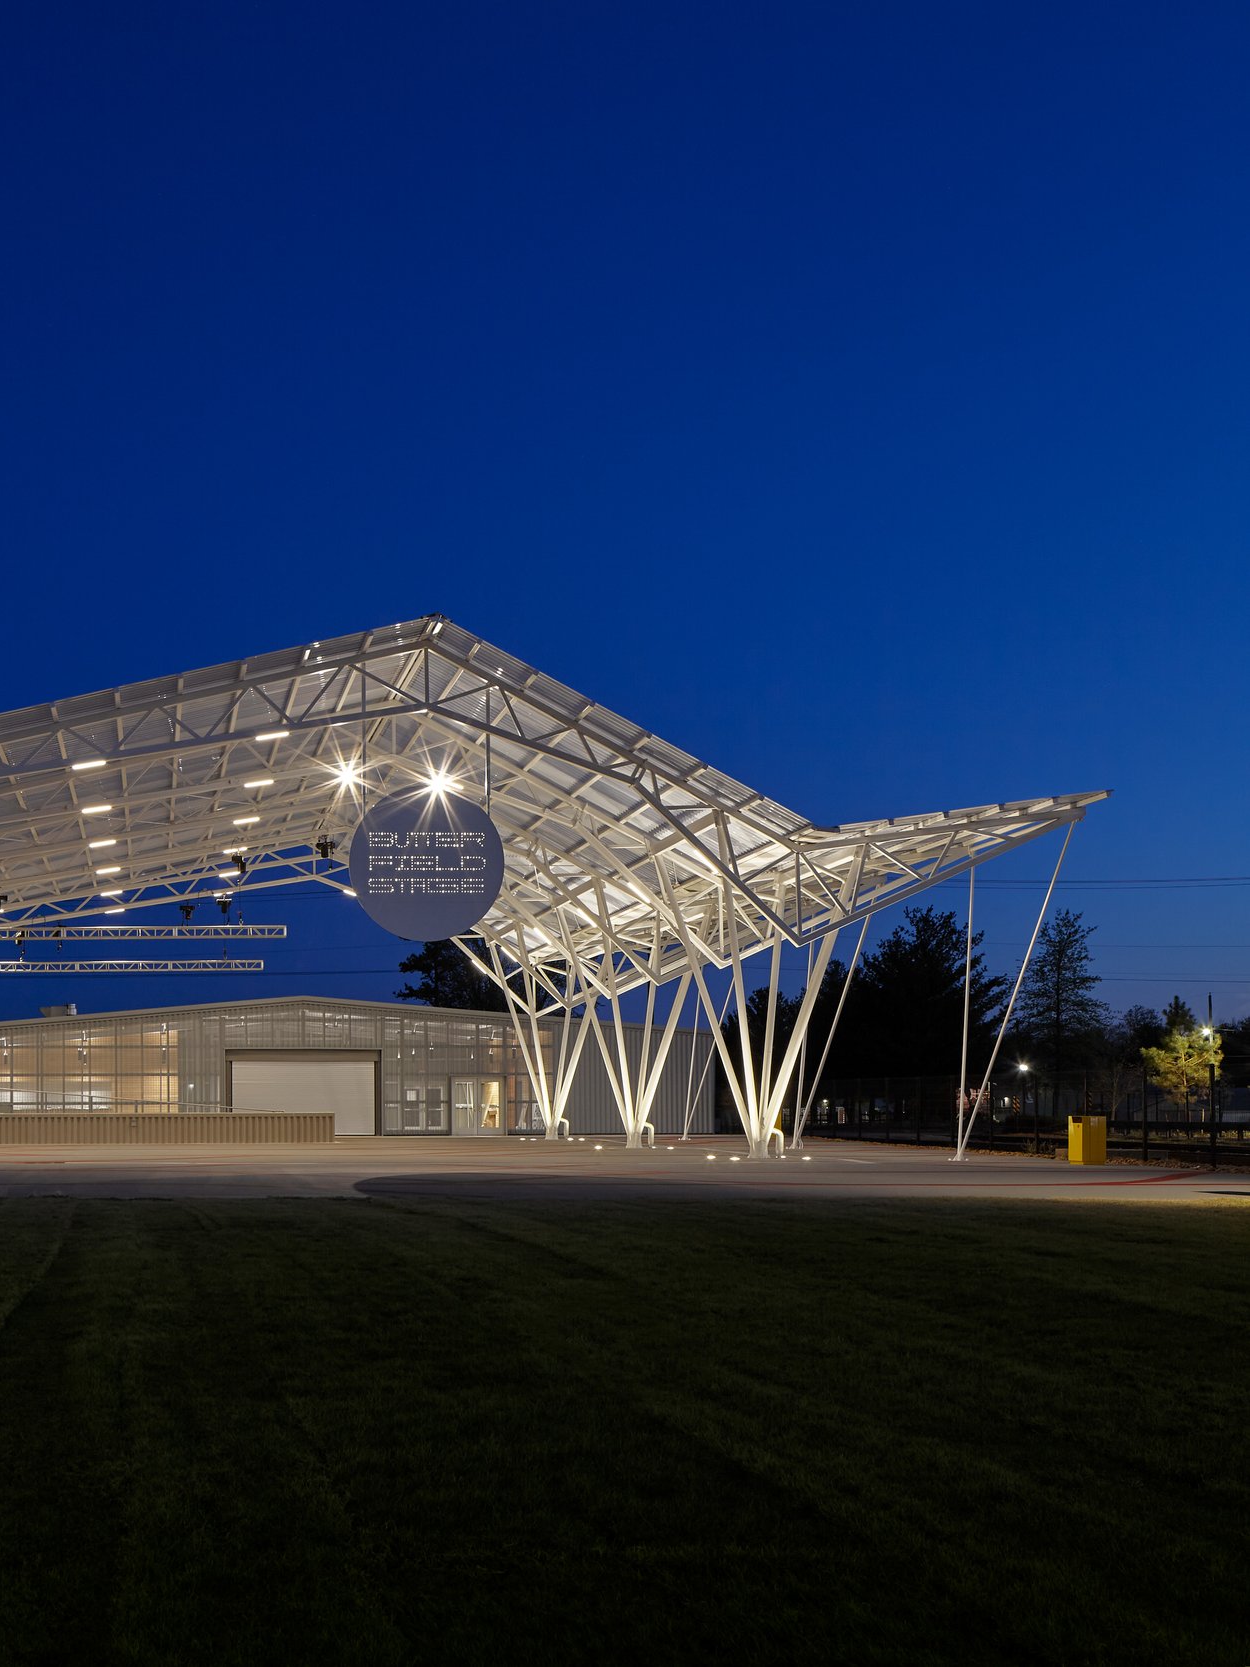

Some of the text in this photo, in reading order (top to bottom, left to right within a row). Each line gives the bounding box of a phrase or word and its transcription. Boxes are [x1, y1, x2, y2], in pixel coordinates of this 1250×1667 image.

[368, 831, 486, 849] BUTTER
[368, 855, 487, 871] FIELD
[367, 877, 485, 894] STAGE
